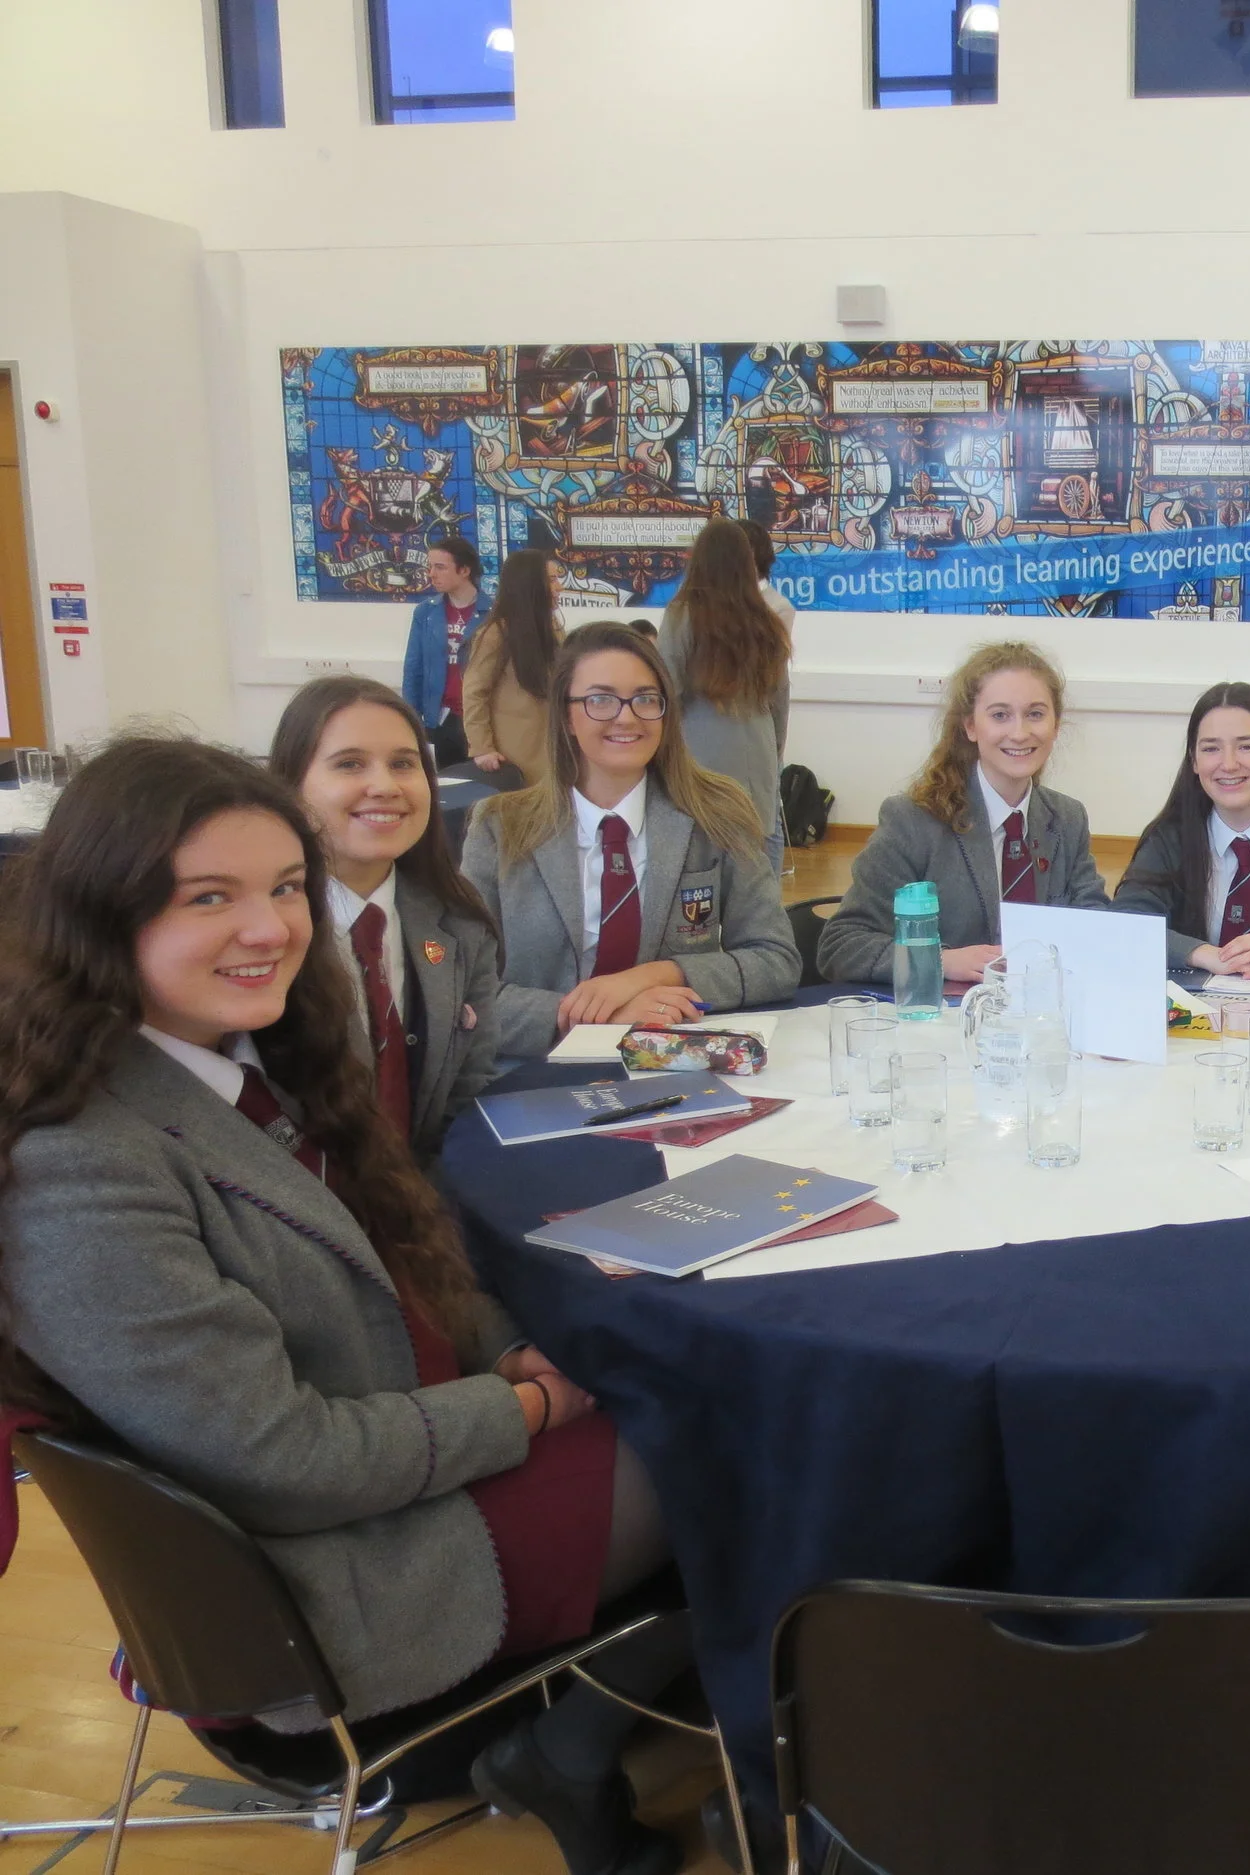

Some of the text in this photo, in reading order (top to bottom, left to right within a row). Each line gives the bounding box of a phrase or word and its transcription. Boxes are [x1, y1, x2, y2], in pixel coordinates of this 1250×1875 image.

[840, 386, 979, 398] Nothing great was ever achieved
[840, 399, 874, 408] without
[903, 515, 940, 526] NEWTON
[586, 521, 600, 533] put
[635, 522, 661, 531] round
[664, 522, 691, 531] about
[576, 534, 600, 542] earth
[604, 534, 612, 542] in
[616, 534, 638, 545] forty
[640, 534, 672, 542] minutes
[828, 558, 1004, 597] outstanding
[1017, 548, 1120, 584] learning
[633, 1200, 708, 1224] House
[656, 1193, 741, 1219] Europe
